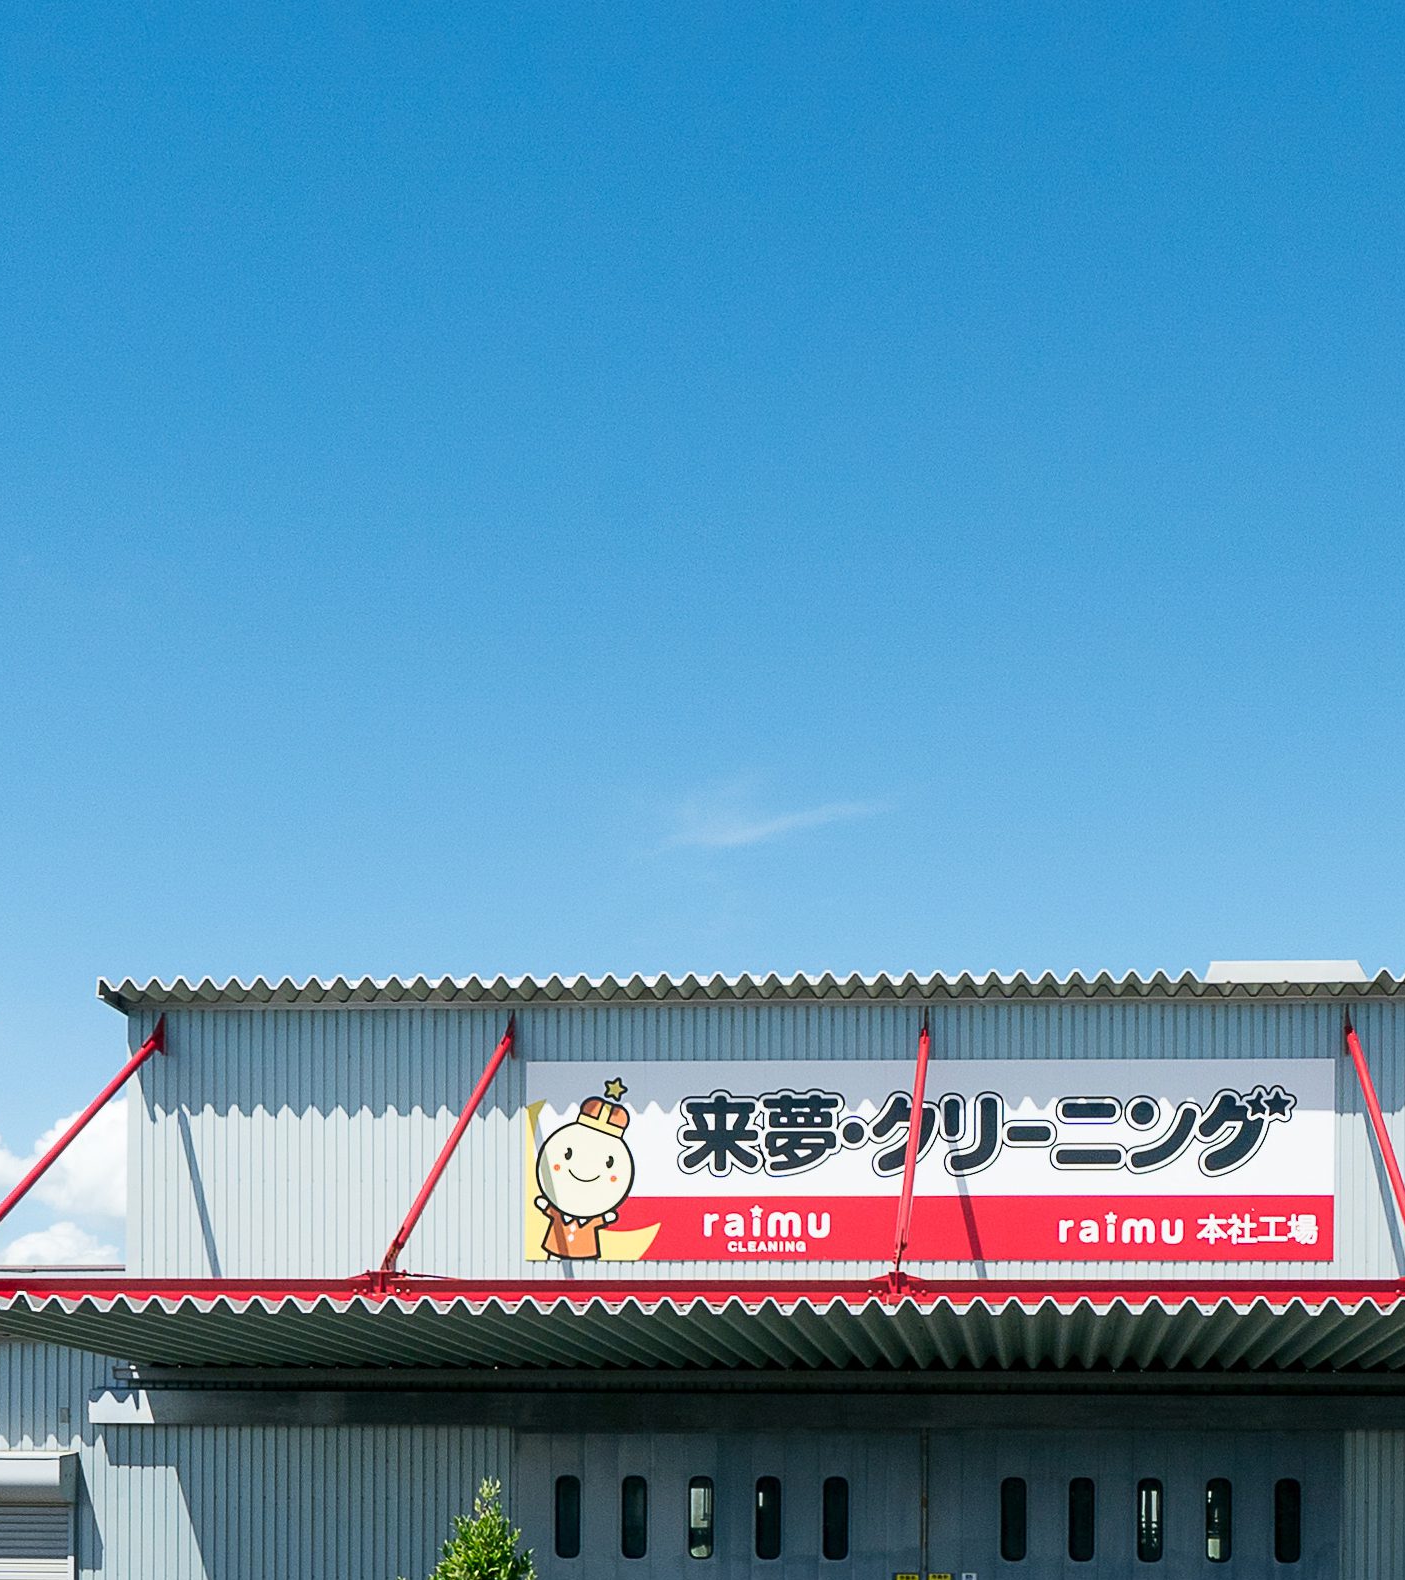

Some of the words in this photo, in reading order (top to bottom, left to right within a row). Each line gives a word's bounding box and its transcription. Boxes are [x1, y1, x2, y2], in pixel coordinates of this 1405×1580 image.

[678, 1087, 1296, 1177] 来夢・クリーニング
[703, 1204, 831, 1238] raimu
[1058, 1211, 1184, 1244] raimu
[1196, 1213, 1319, 1245] 本社工場
[727, 1241, 807, 1253] CLEANING
